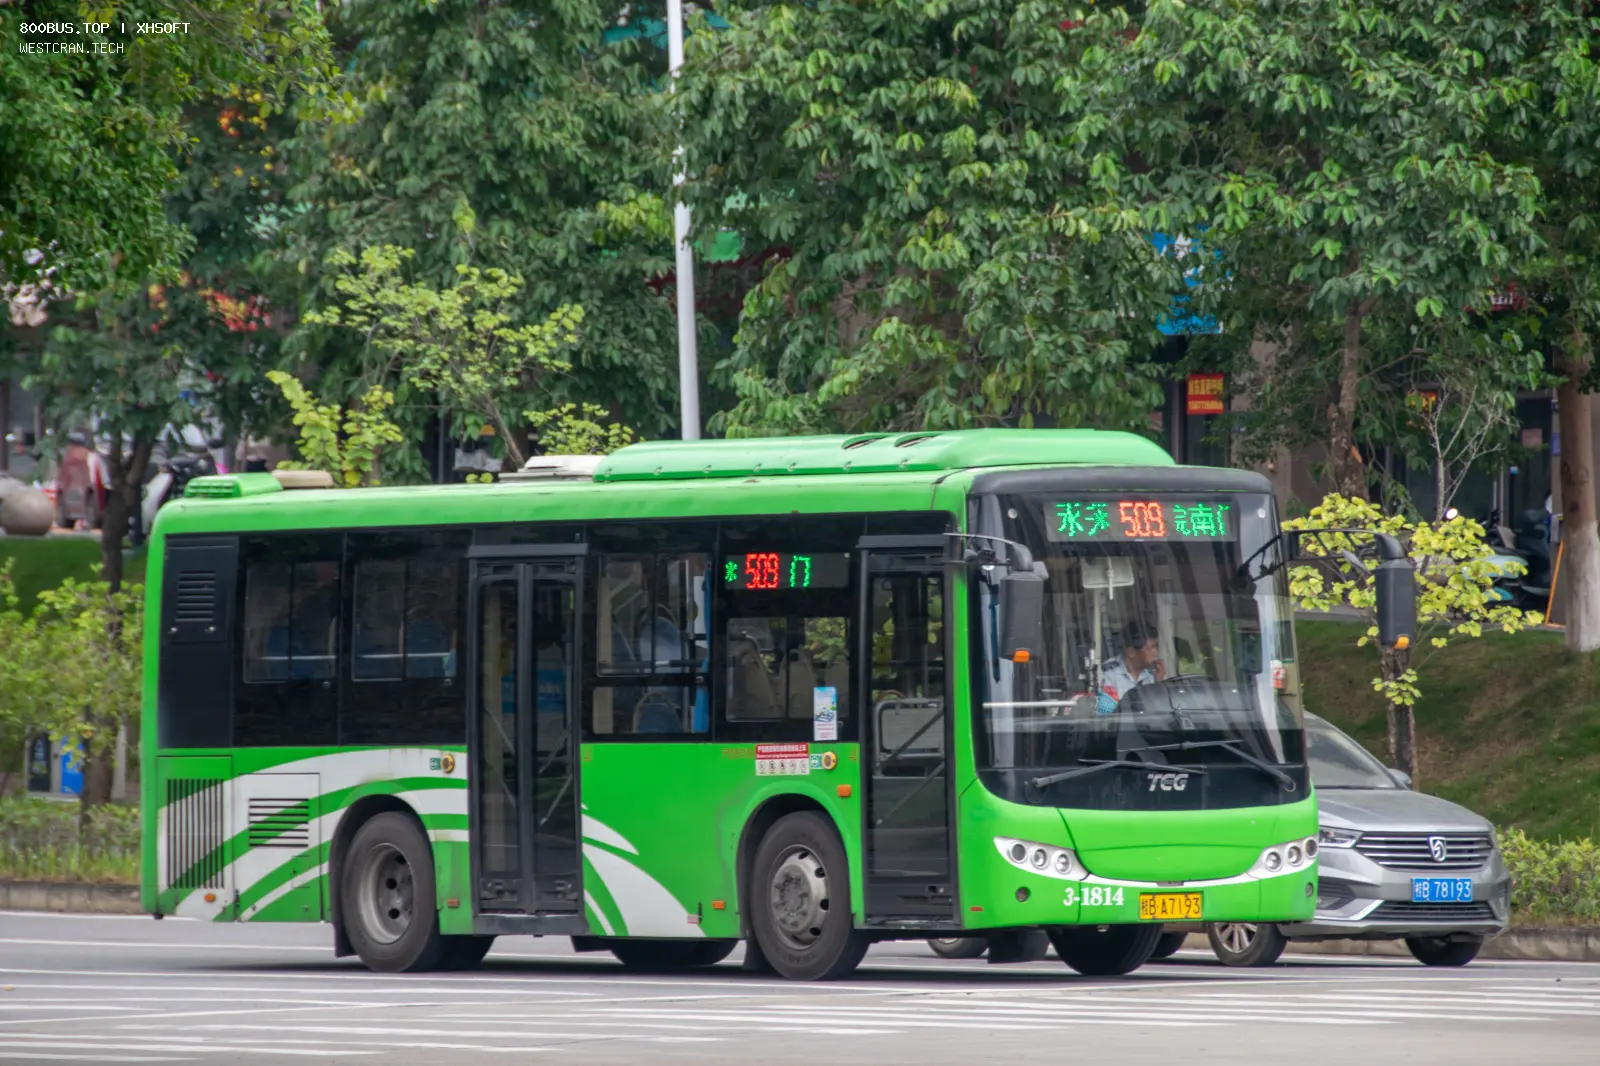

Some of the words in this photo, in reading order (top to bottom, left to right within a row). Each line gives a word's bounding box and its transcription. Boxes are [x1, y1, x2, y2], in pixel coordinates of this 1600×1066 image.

[1119, 502, 1166, 537] 509
[745, 553, 779, 589] 509
[1147, 773, 1189, 792] TEG
[1063, 887, 1125, 907] 3-1814
